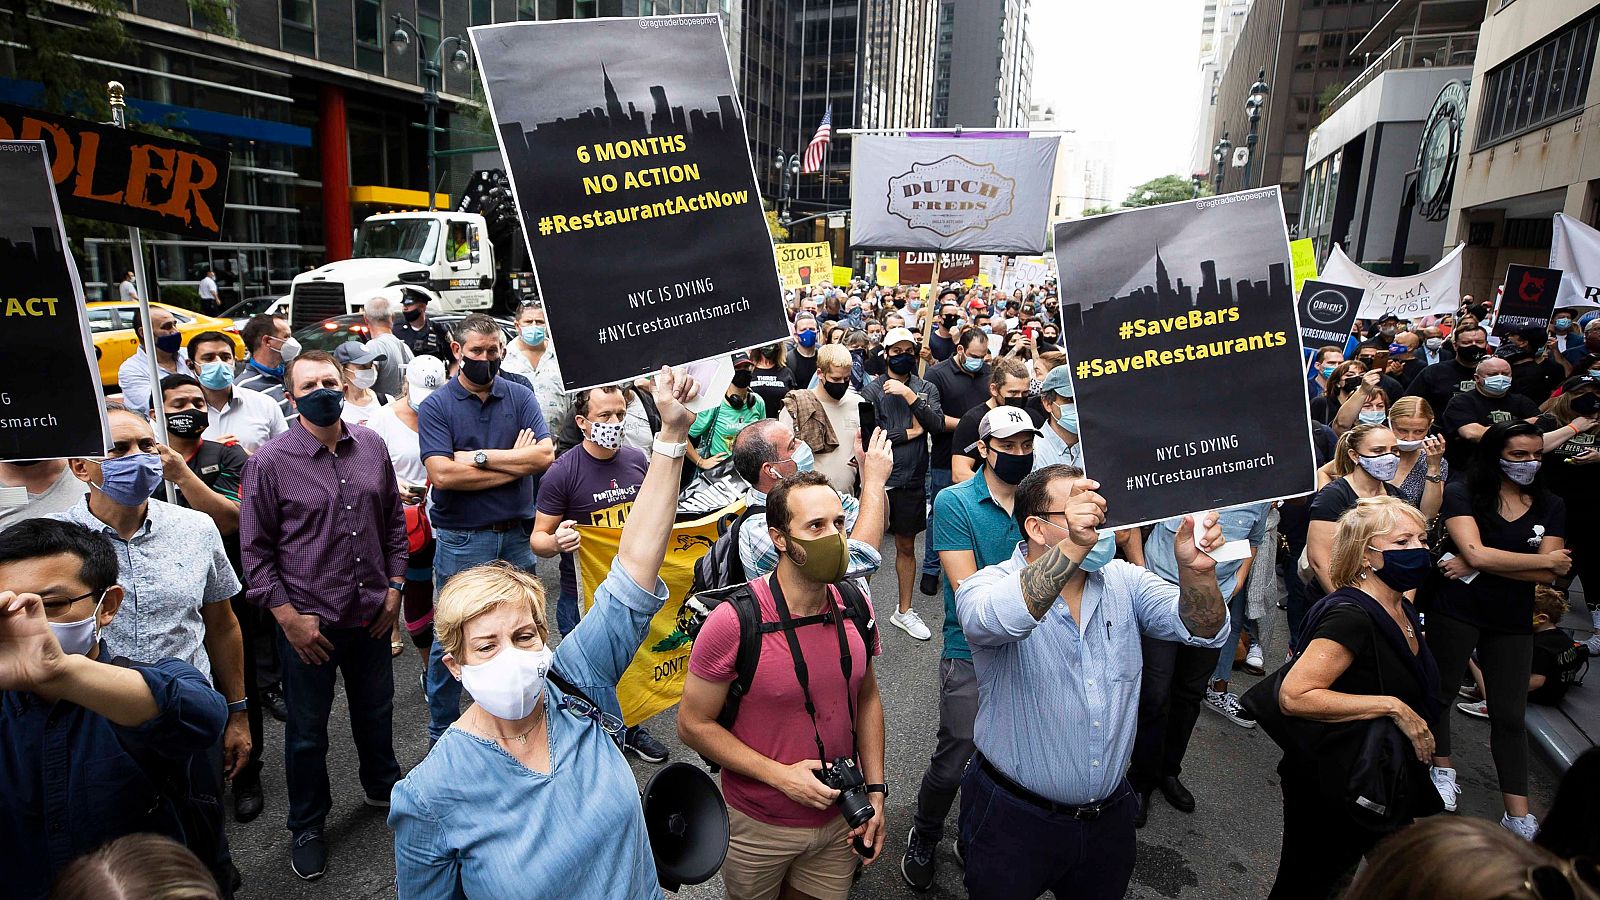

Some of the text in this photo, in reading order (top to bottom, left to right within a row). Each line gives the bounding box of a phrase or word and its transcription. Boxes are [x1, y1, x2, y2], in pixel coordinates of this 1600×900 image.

[576, 134, 687, 164] 6 MONTHS
[582, 163, 700, 195] NO ACTION
[902, 179, 1000, 198] DUTCH
[538, 190, 749, 236] #RestaurantActNow
[912, 201, 989, 210] FREDS
[1196, 190, 1276, 210] @ragtraderbopeepnyc
[782, 245, 823, 262] STOUT
[628, 277, 714, 309] NYC IS DYING
[598, 296, 750, 344] #NYCrestaurantsmarch
[1119, 305, 1240, 341] #SaveBars
[1076, 329, 1287, 380] #SaveRestaurants
[1156, 434, 1239, 462] NYC IS DYING
[1126, 452, 1274, 491] #NYCrestaurantsmarch
[654, 655, 688, 682] DONT
